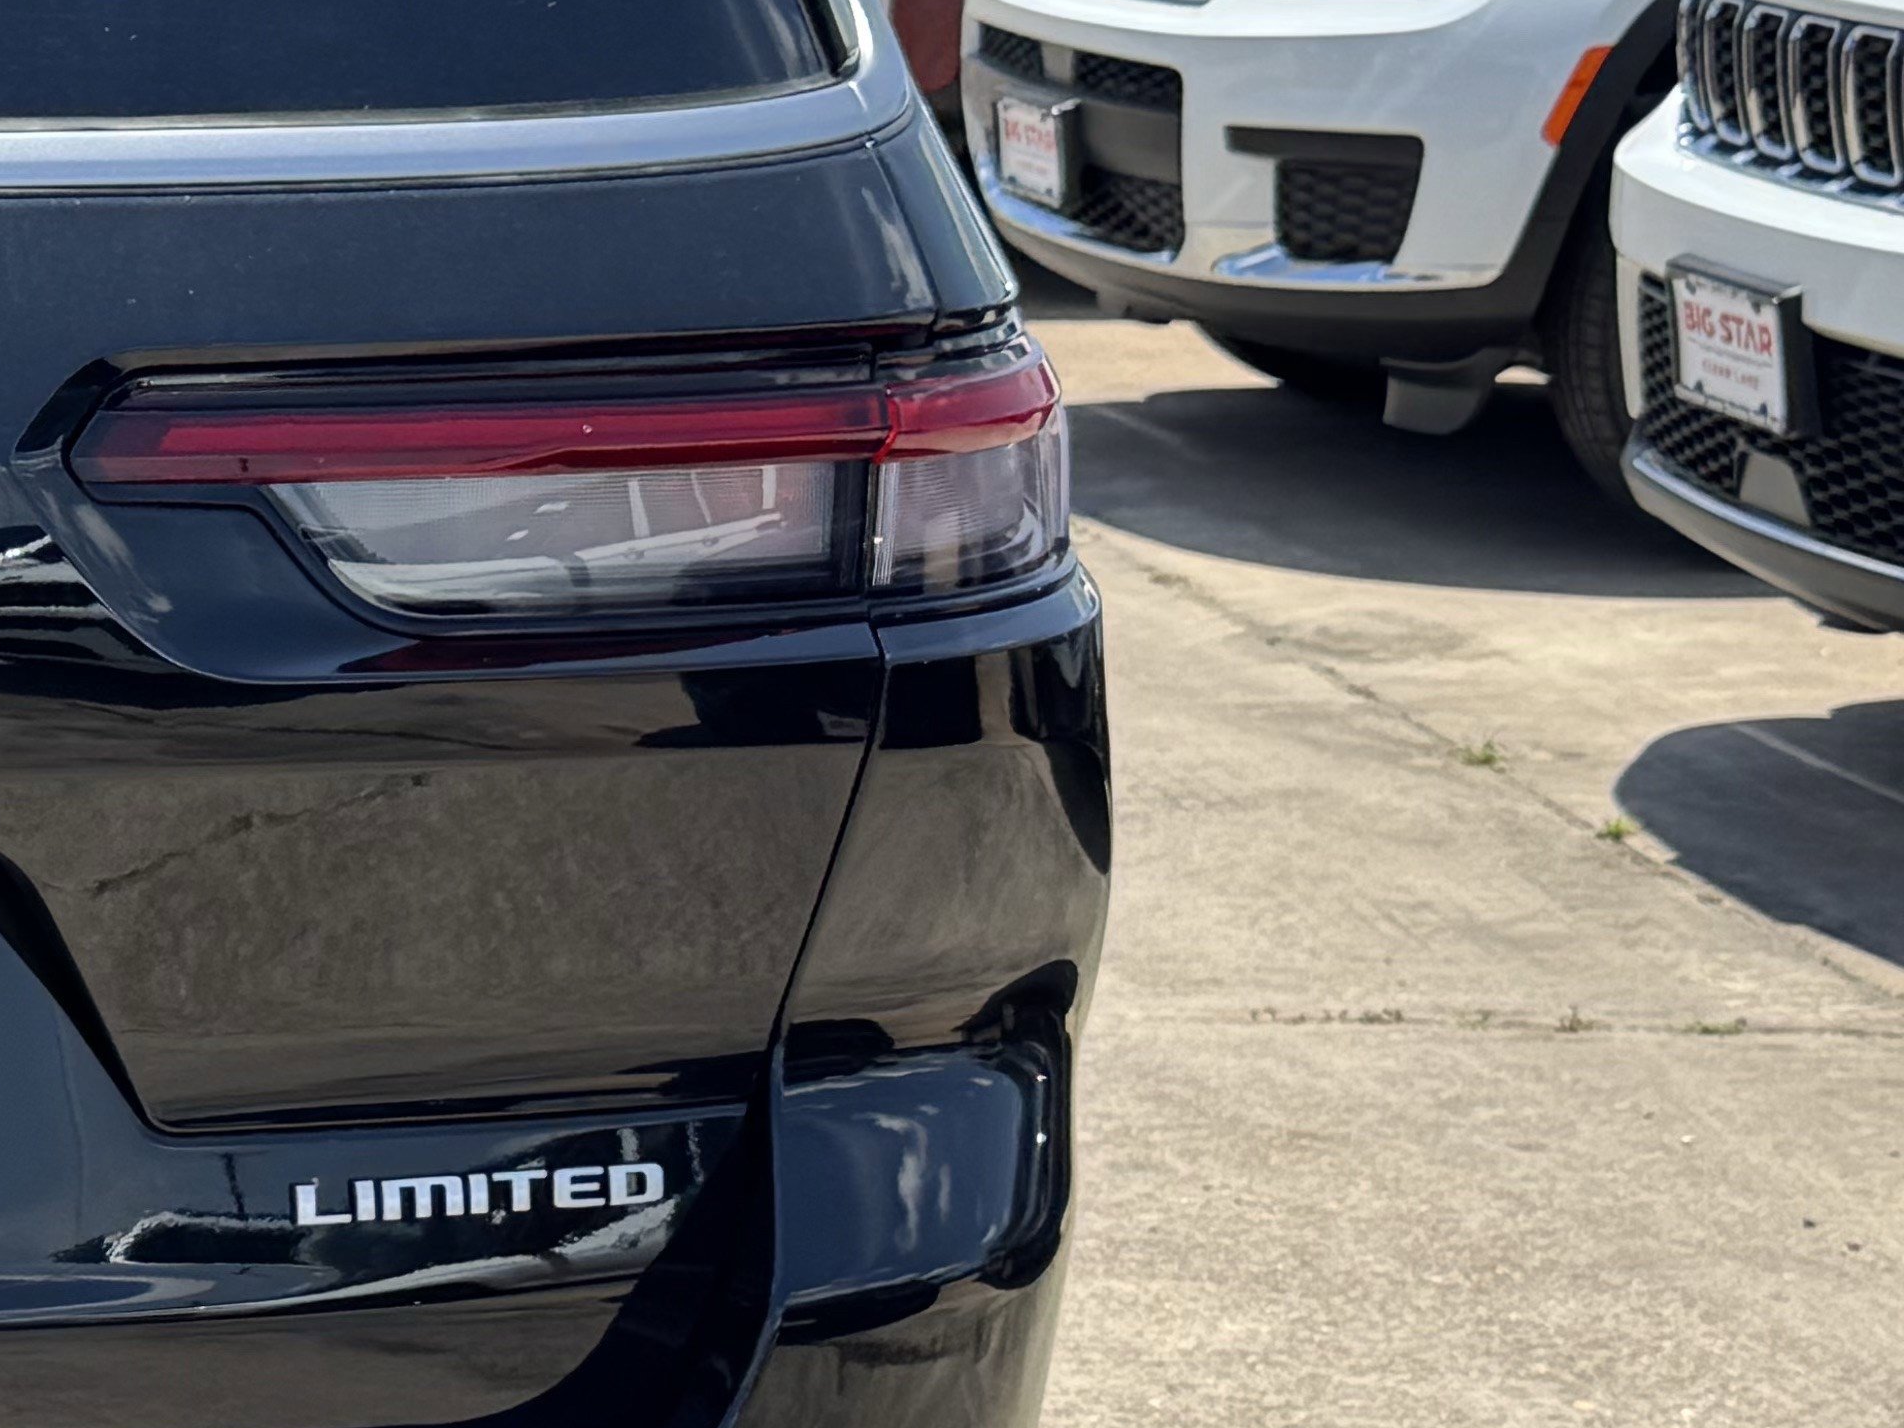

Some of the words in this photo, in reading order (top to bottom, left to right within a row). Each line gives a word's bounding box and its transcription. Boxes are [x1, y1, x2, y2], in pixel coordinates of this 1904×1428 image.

[1683, 300, 1716, 339] BIG
[1719, 311, 1773, 357] STAR
[294, 1162, 666, 1227] LIMITED
